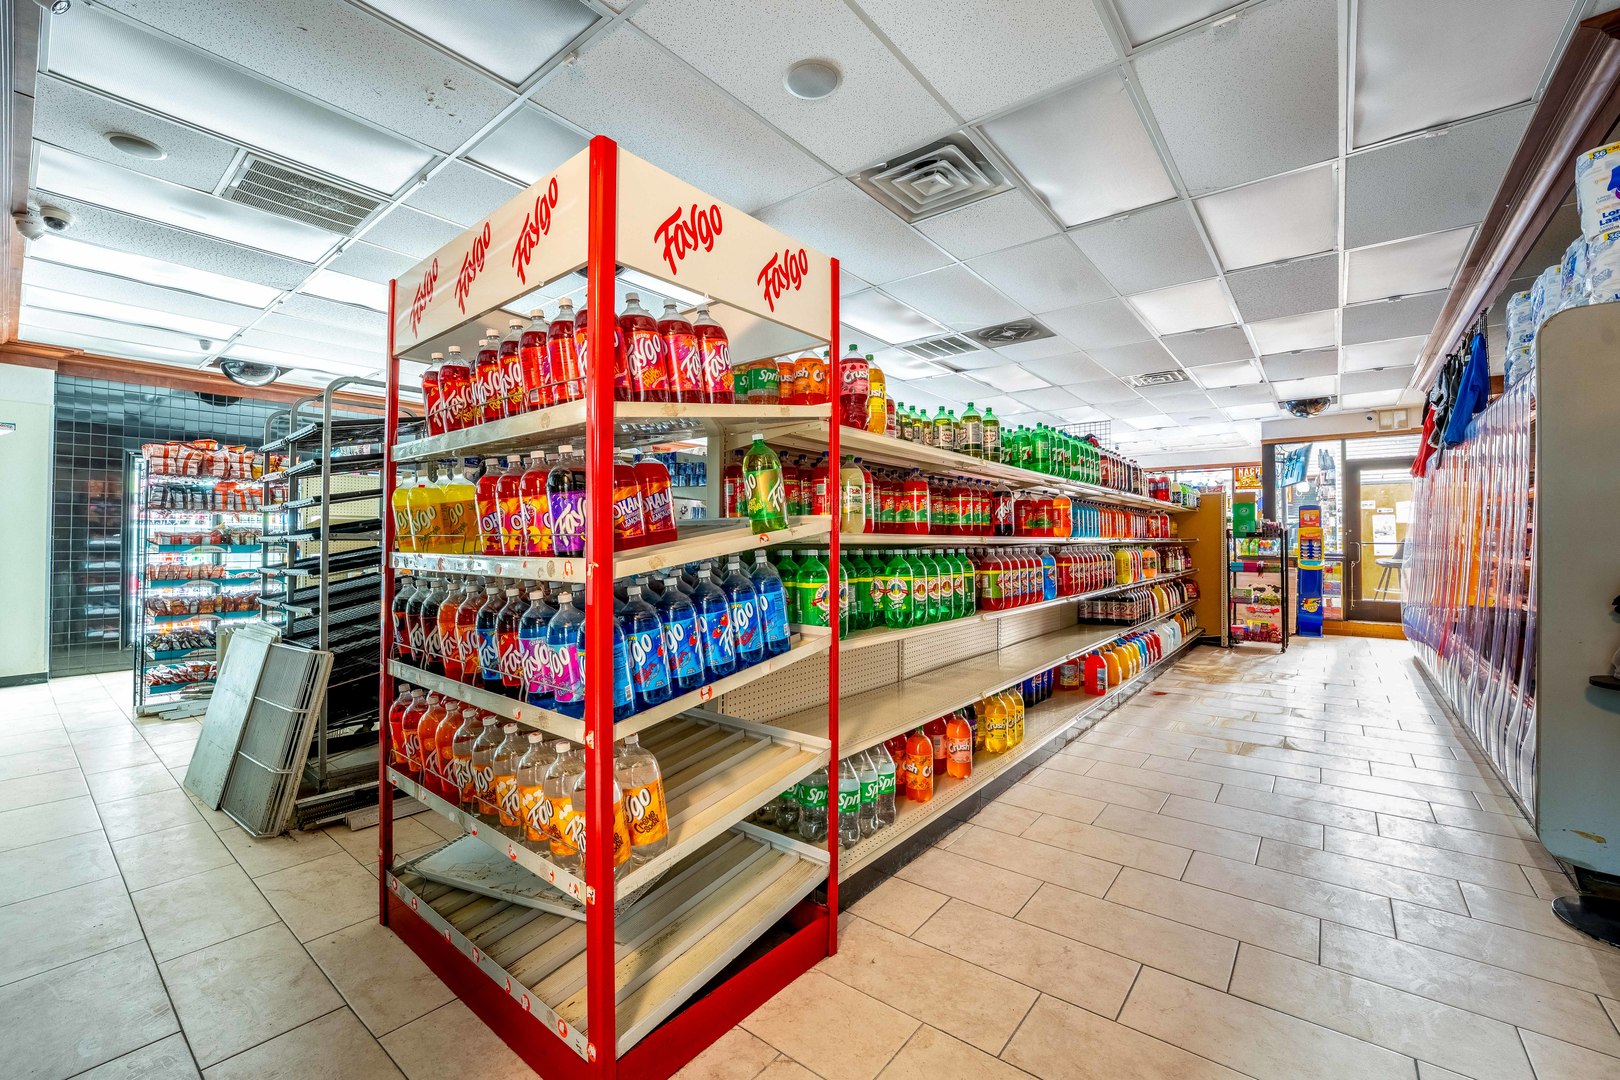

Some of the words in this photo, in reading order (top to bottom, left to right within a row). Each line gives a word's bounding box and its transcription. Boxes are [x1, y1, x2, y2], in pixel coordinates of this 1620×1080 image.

[511, 176, 558, 285] Faygo
[653, 203, 723, 276] Faygo
[409, 257, 439, 339] Faygo
[454, 221, 491, 315] Faygo
[757, 248, 809, 313] Faygo
[702, 344, 732, 388] Fayg
[554, 497, 586, 547] Fay
[948, 742, 970, 753] Crush
[986, 718, 1006, 731] Crush
